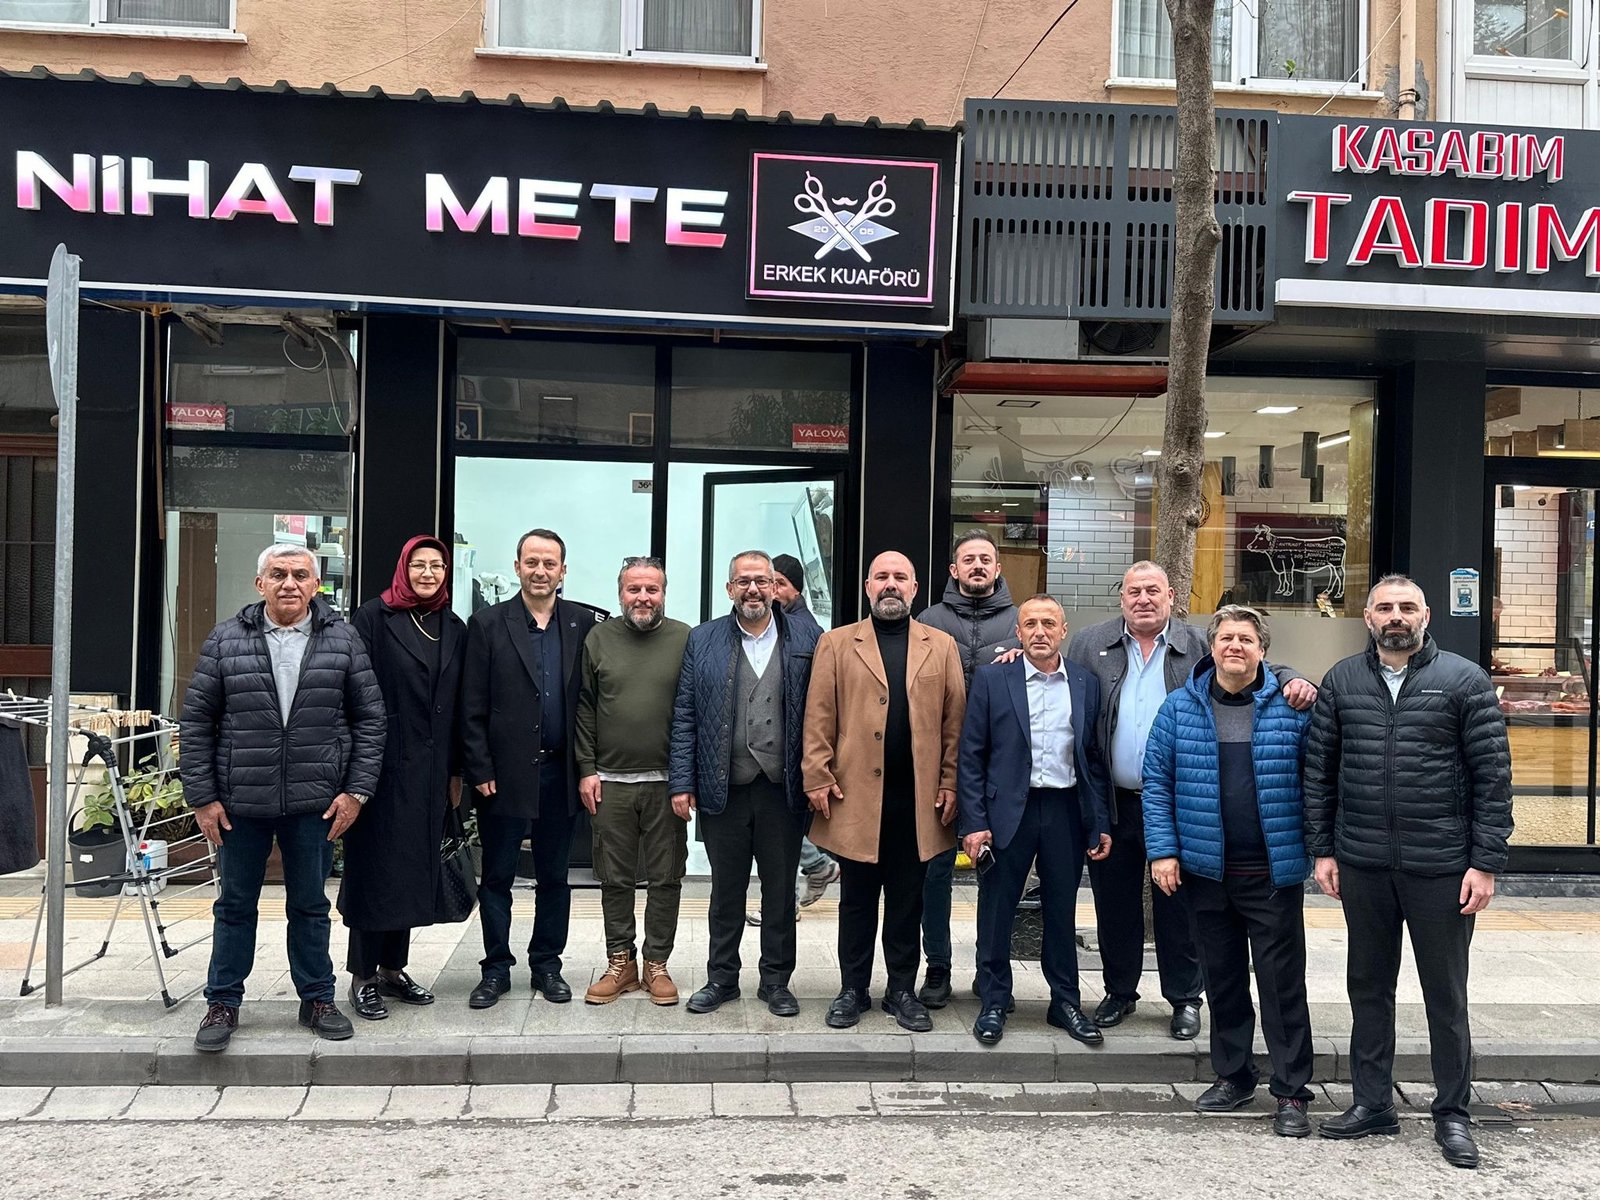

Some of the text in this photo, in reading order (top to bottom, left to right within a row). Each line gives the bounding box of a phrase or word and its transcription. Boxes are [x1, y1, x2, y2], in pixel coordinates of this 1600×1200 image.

[1332, 124, 1565, 183] KASABIM
[425, 173, 729, 249] METE
[813, 225, 875, 236] 20 05
[1287, 190, 1600, 278] TADIM
[763, 264, 920, 287] ERKEK KUAFÖRÜ
[171, 406, 223, 418] YALOVA
[798, 429, 846, 438] YALOVA
